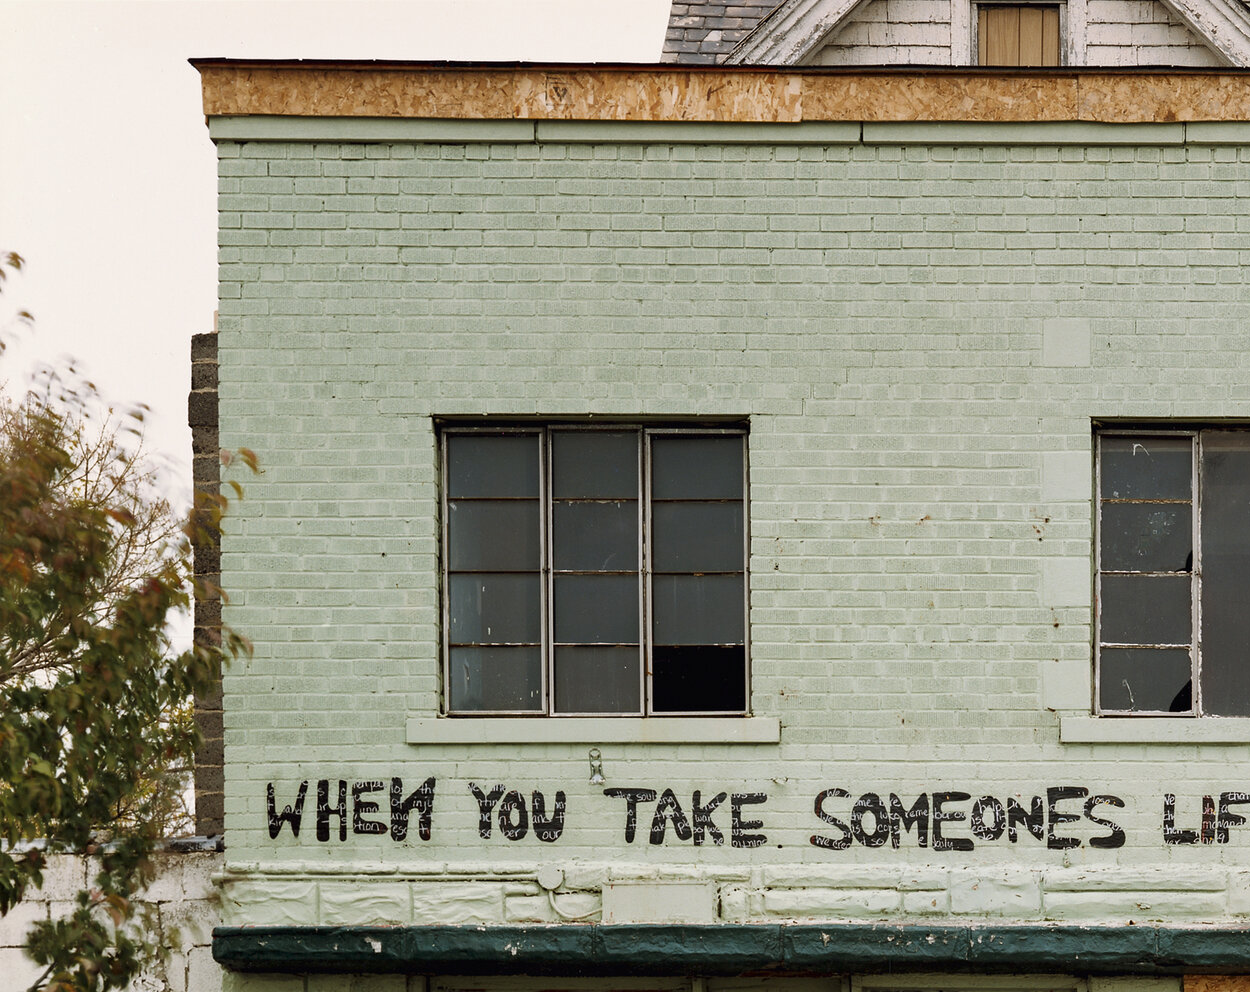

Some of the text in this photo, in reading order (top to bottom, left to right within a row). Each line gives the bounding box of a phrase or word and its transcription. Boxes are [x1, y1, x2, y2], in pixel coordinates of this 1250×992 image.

[266, 777, 436, 842] WHEN
[467, 781, 567, 843] YOU
[604, 787, 768, 847] TAKE
[811, 785, 1126, 851] SOMEONES
